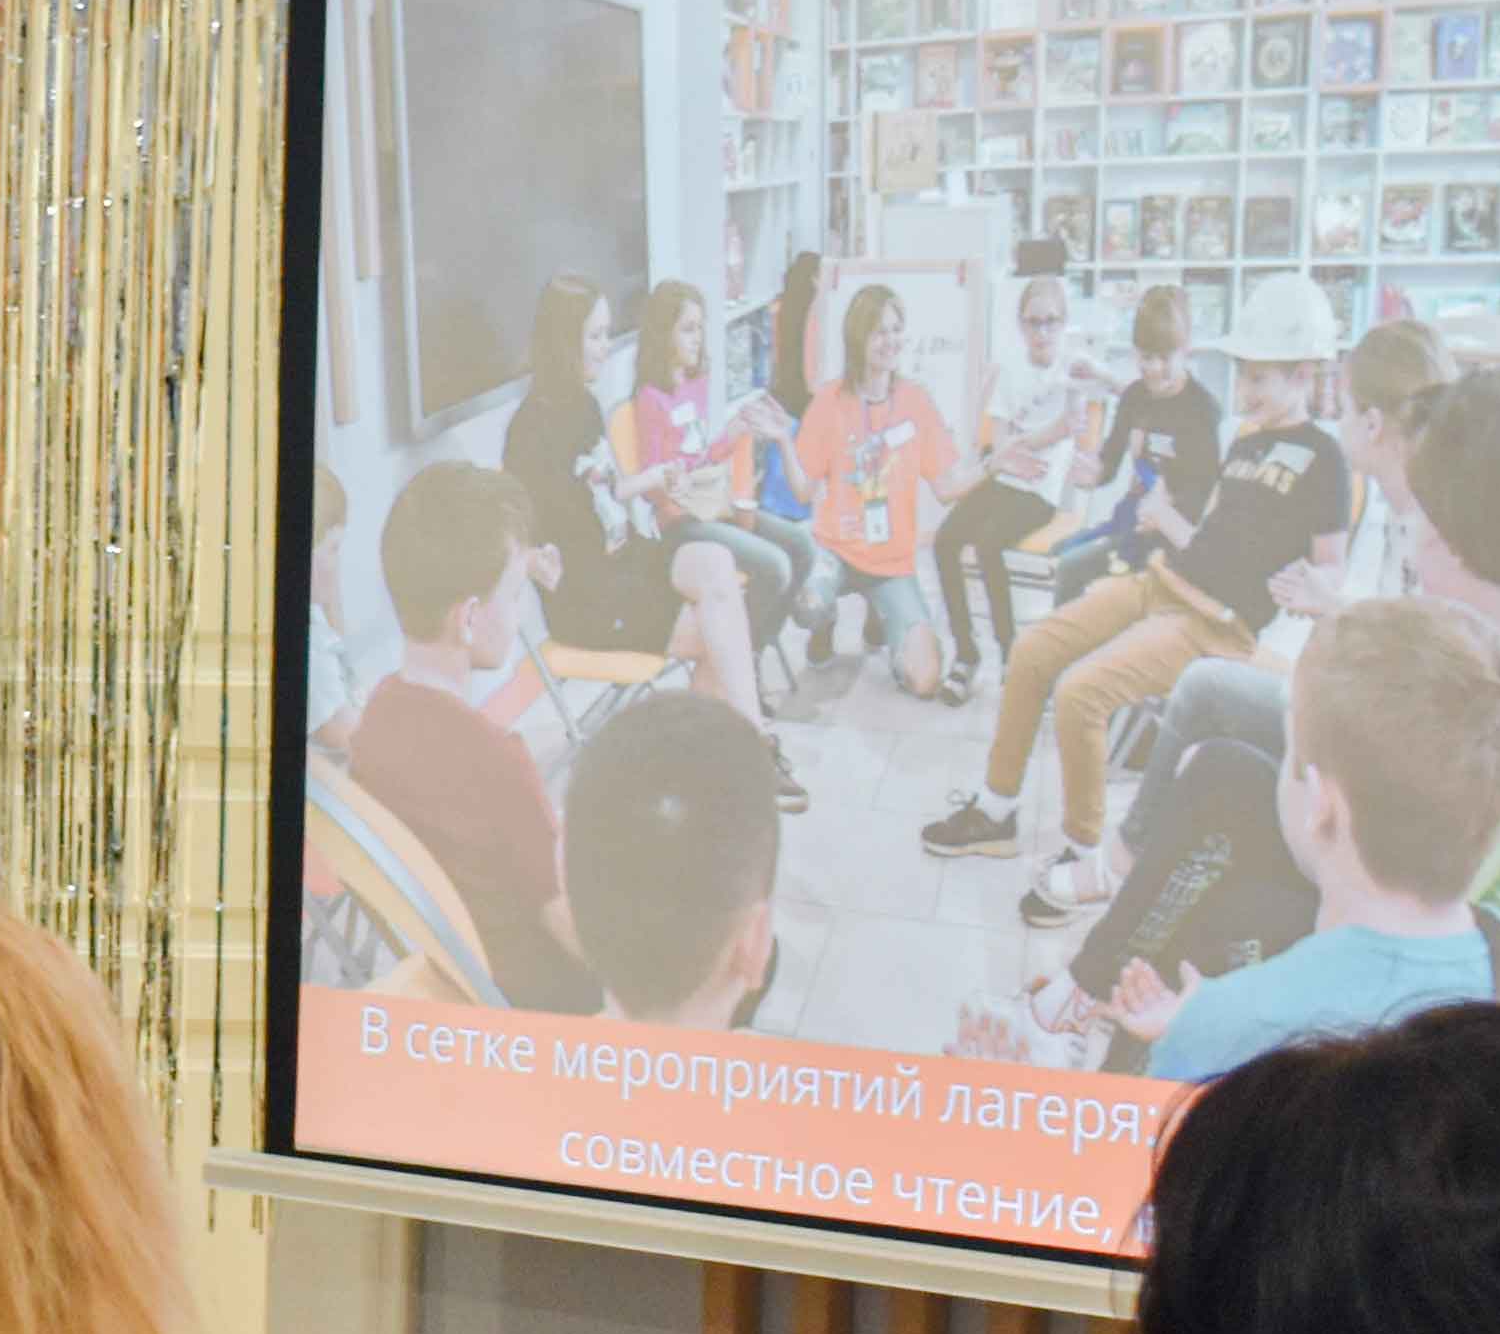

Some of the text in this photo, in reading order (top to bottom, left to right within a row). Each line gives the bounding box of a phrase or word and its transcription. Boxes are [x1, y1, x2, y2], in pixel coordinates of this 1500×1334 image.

[360, 1005, 389, 1054] В
[406, 1022, 536, 1073] сетке
[553, 1039, 922, 1121] мероприятий
[938, 1082, 1158, 1155] лагеря:
[560, 1131, 874, 1205] совместное
[893, 1172, 1113, 1244] чтение,
